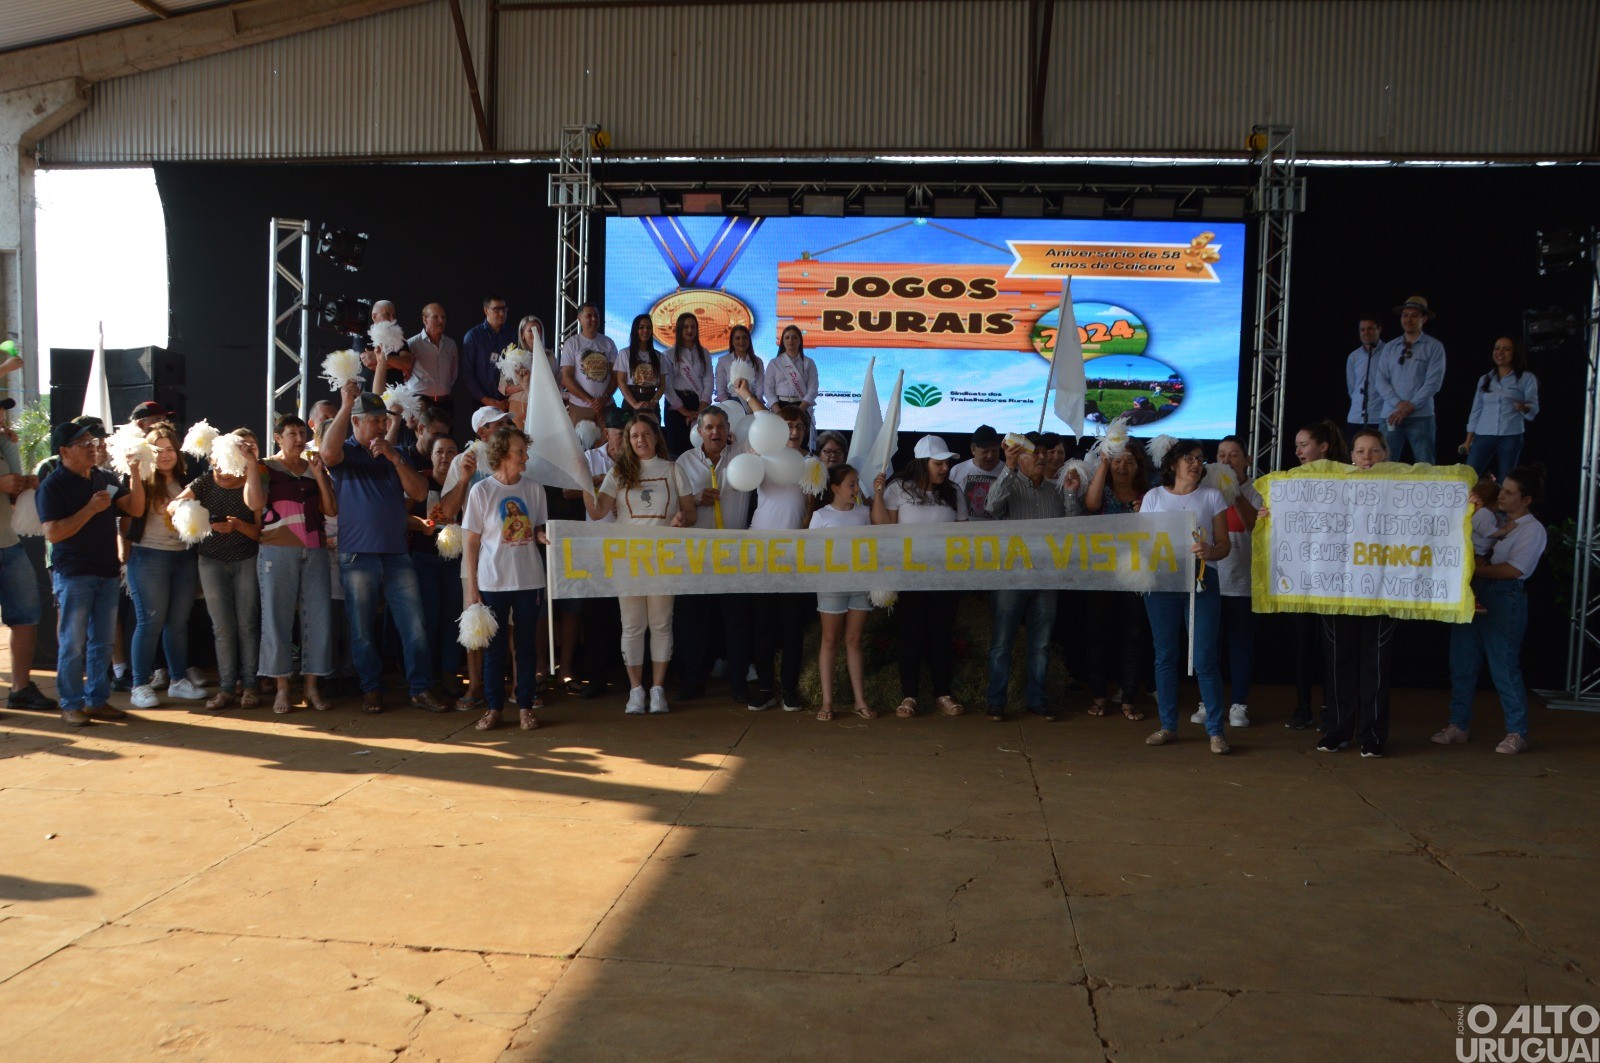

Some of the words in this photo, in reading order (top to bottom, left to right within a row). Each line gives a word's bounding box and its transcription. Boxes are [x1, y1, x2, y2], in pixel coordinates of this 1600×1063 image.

[1045, 248, 1135, 259] Aniversário
[1139, 250, 1157, 260] de
[1161, 250, 1181, 260] 58
[1051, 261, 1087, 270] anos
[1091, 261, 1109, 270] de
[1113, 261, 1176, 272] Caiçara
[825, 276, 998, 300] JOGOS
[822, 309, 1015, 335] RURAIS
[1270, 480, 1337, 504] JUNTOS
[1342, 482, 1380, 506] NOS
[1393, 483, 1468, 509] JOGOS
[1285, 511, 1354, 534] FAZENDO
[1367, 511, 1449, 536] HISTÓRIA
[602, 538, 879, 578] PREVEDELLO
[945, 535, 1034, 571] BOA
[1045, 531, 1179, 573] VISTA
[1278, 540, 1293, 562] A
[1299, 541, 1350, 563] EQUIPE
[1353, 542, 1433, 567] BRANCA
[1432, 546, 1460, 568] VAI
[1300, 570, 1353, 592] LEVAR
[1361, 574, 1375, 595] A
[1382, 574, 1448, 598] VITÓRIA
